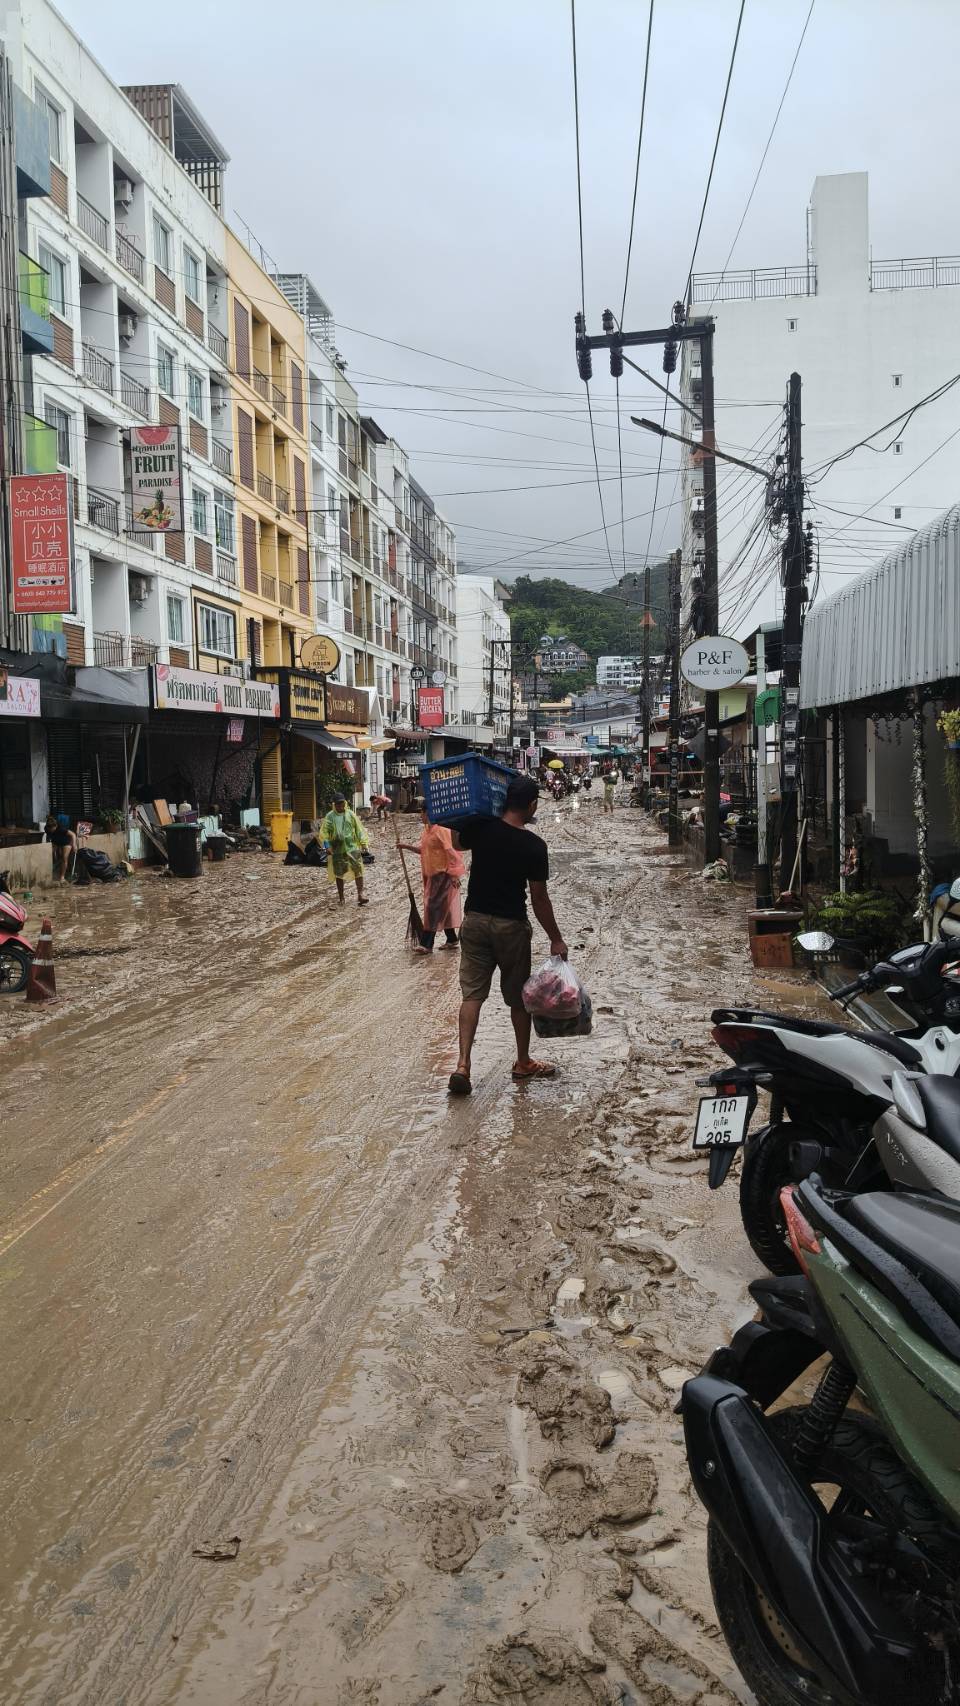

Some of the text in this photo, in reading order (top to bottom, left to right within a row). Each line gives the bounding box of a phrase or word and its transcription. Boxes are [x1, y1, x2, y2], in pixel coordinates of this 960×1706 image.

[135, 455, 175, 473] FRUIT
[139, 478, 172, 488] PARADISE
[15, 505, 66, 518] Small Shells
[32, 521, 62, 539] 小小
[32, 541, 62, 558] 贝壳
[697, 650, 733, 666] P&F
[723, 667, 742, 675] salon
[223, 684, 242, 708] FRUIT
[245, 687, 272, 711] PARADISE
[420, 696, 442, 706] BUTTER
[420, 705, 443, 714] CHICKEN
[706, 1130, 732, 1144] 205
